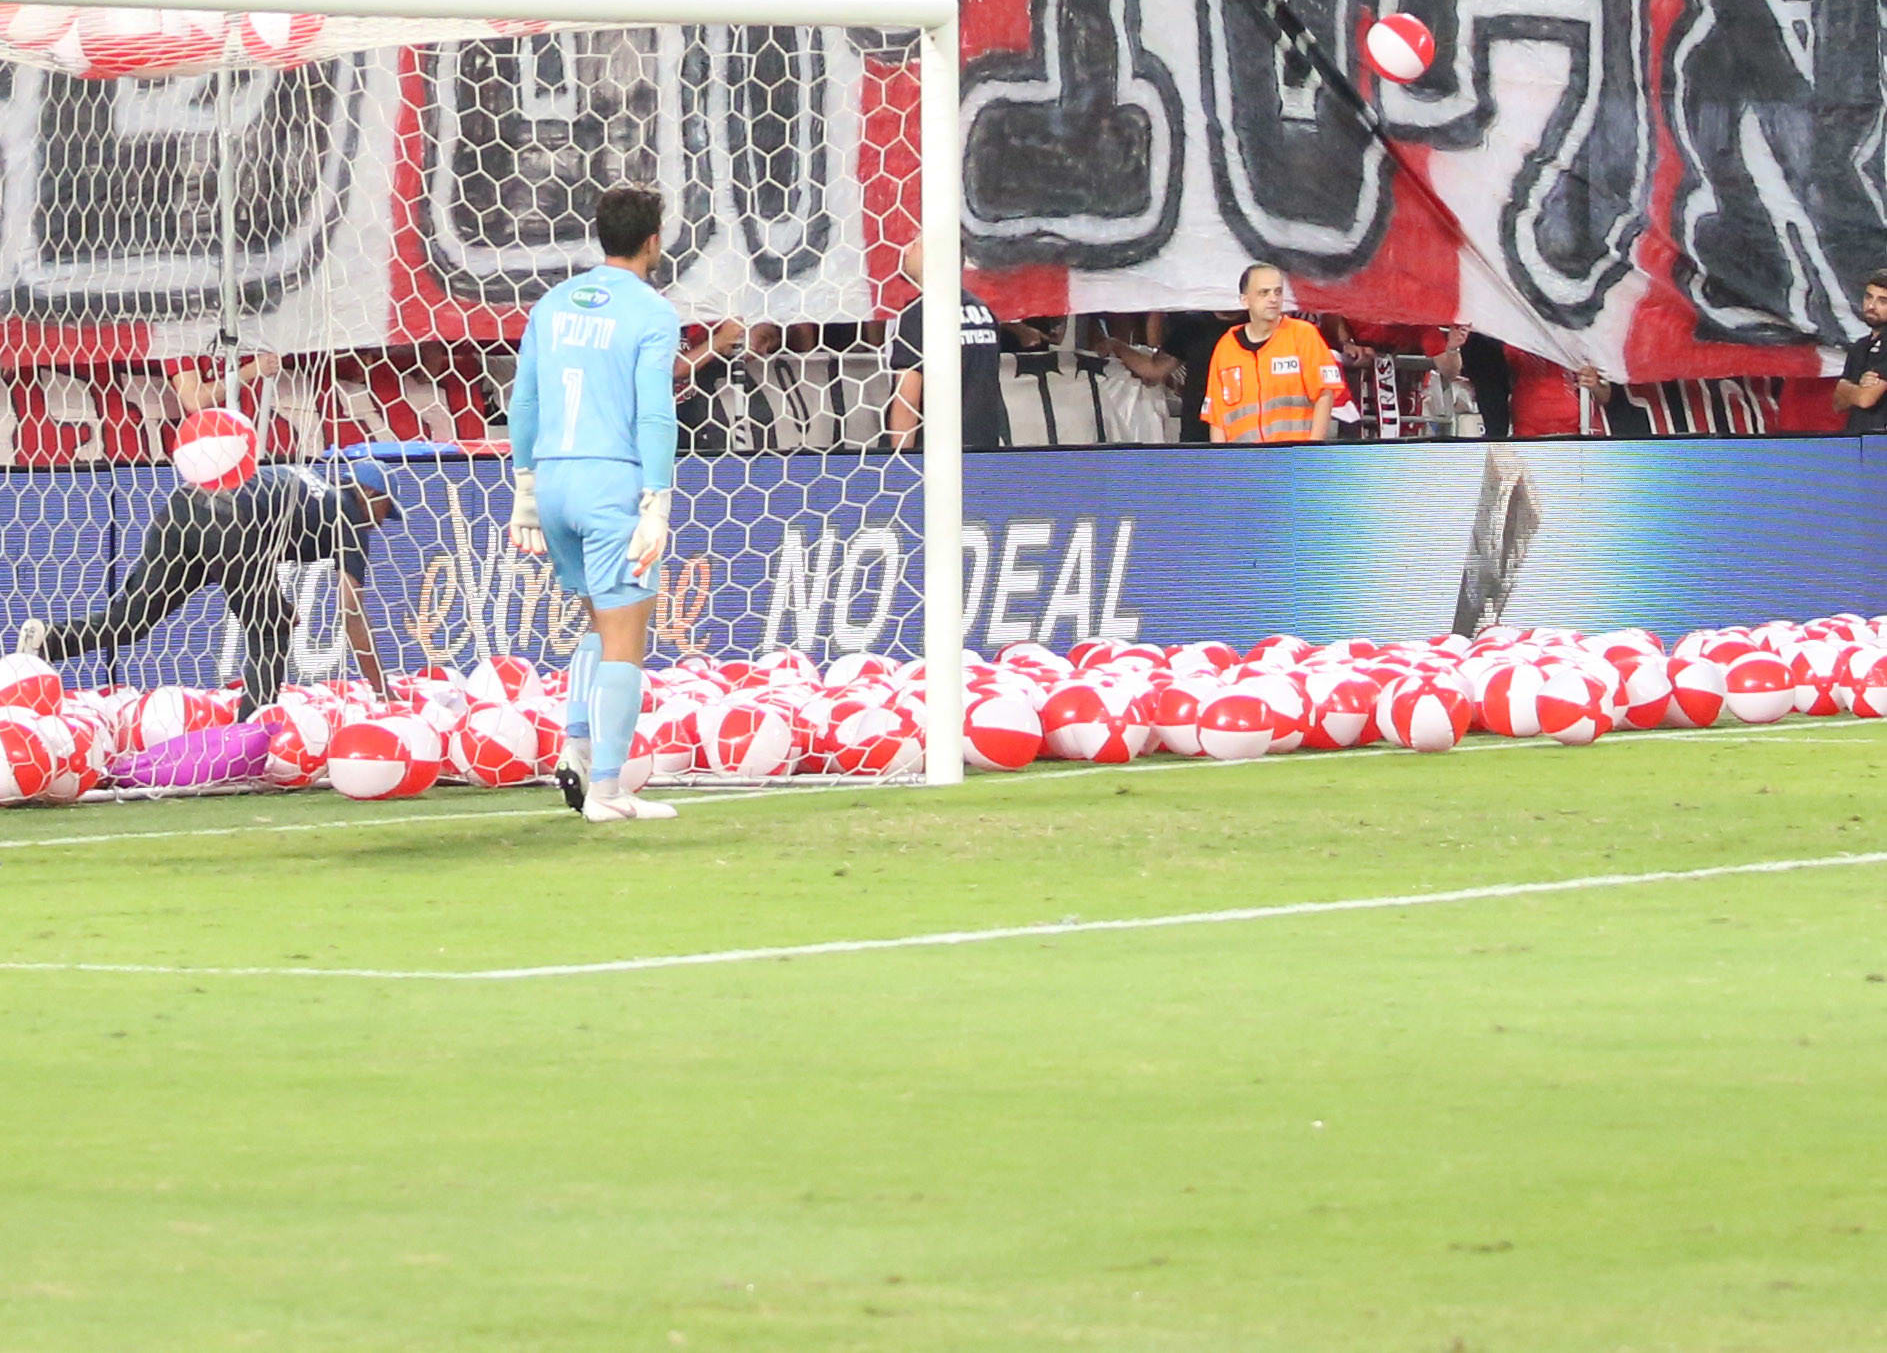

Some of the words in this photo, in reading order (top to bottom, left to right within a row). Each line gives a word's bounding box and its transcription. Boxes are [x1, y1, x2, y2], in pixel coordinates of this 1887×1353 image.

[1272, 359, 1299, 373] סדרן
[561, 367, 585, 452] 1
[762, 526, 903, 654] NO
